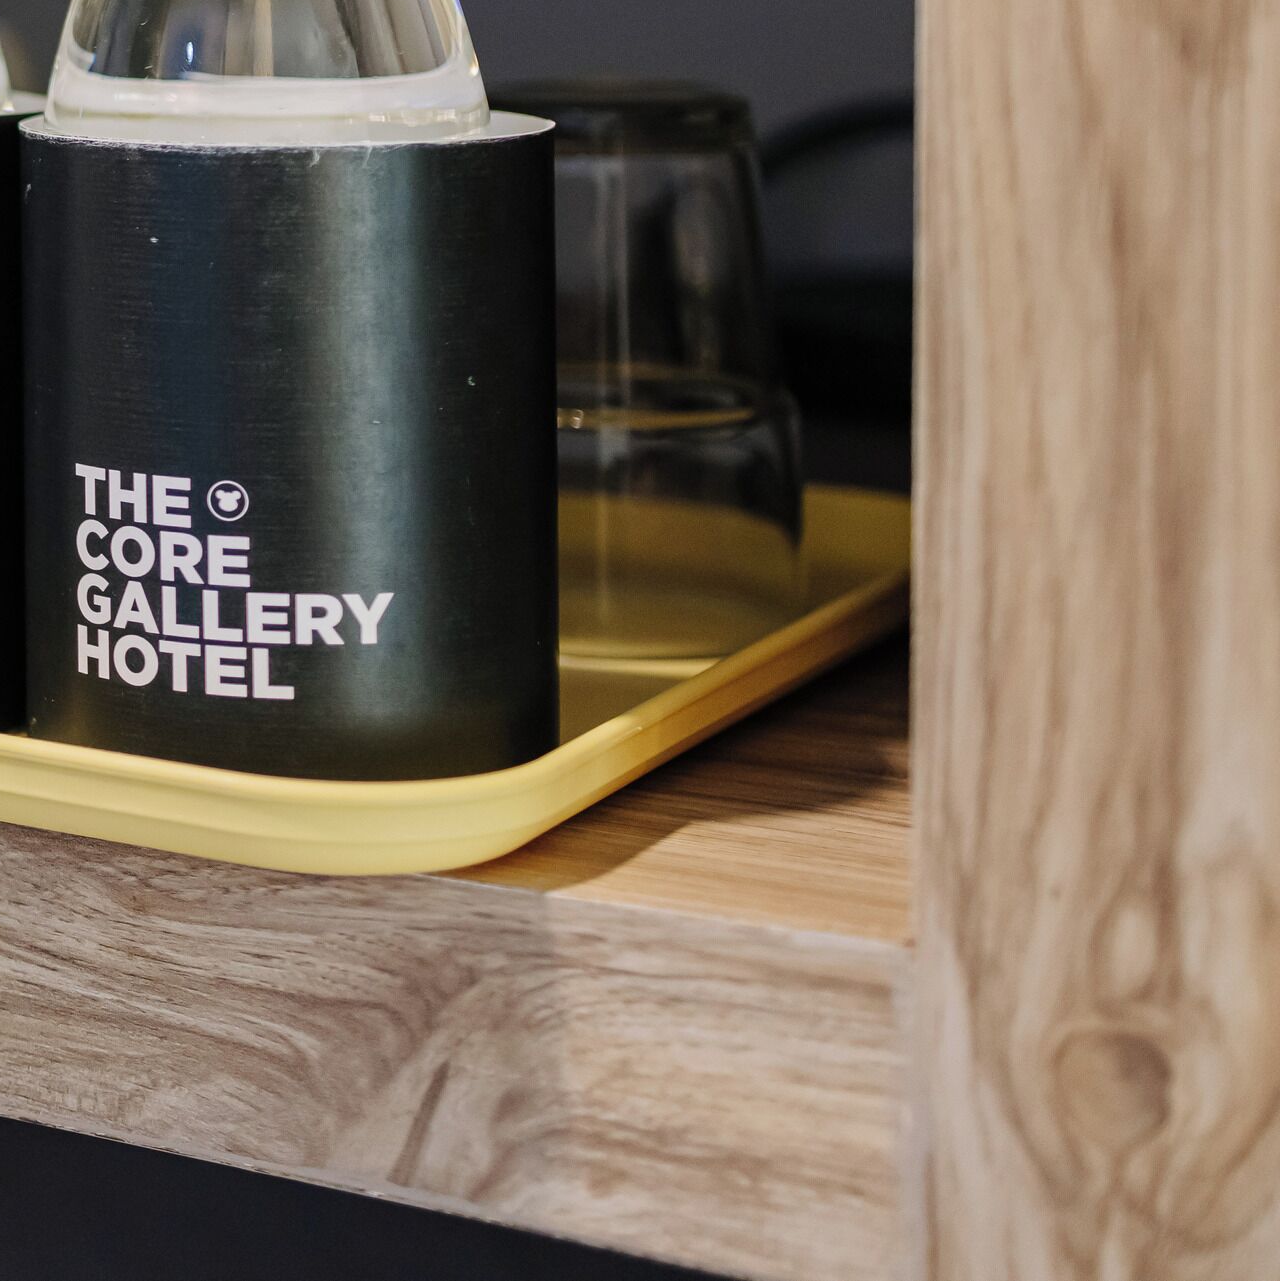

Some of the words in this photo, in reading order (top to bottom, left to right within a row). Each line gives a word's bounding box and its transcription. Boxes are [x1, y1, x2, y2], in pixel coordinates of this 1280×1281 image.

[75, 463, 192, 528] THE
[76, 519, 251, 588] CORE
[77, 573, 395, 645] GALLERY
[77, 623, 295, 700] HOTEL
